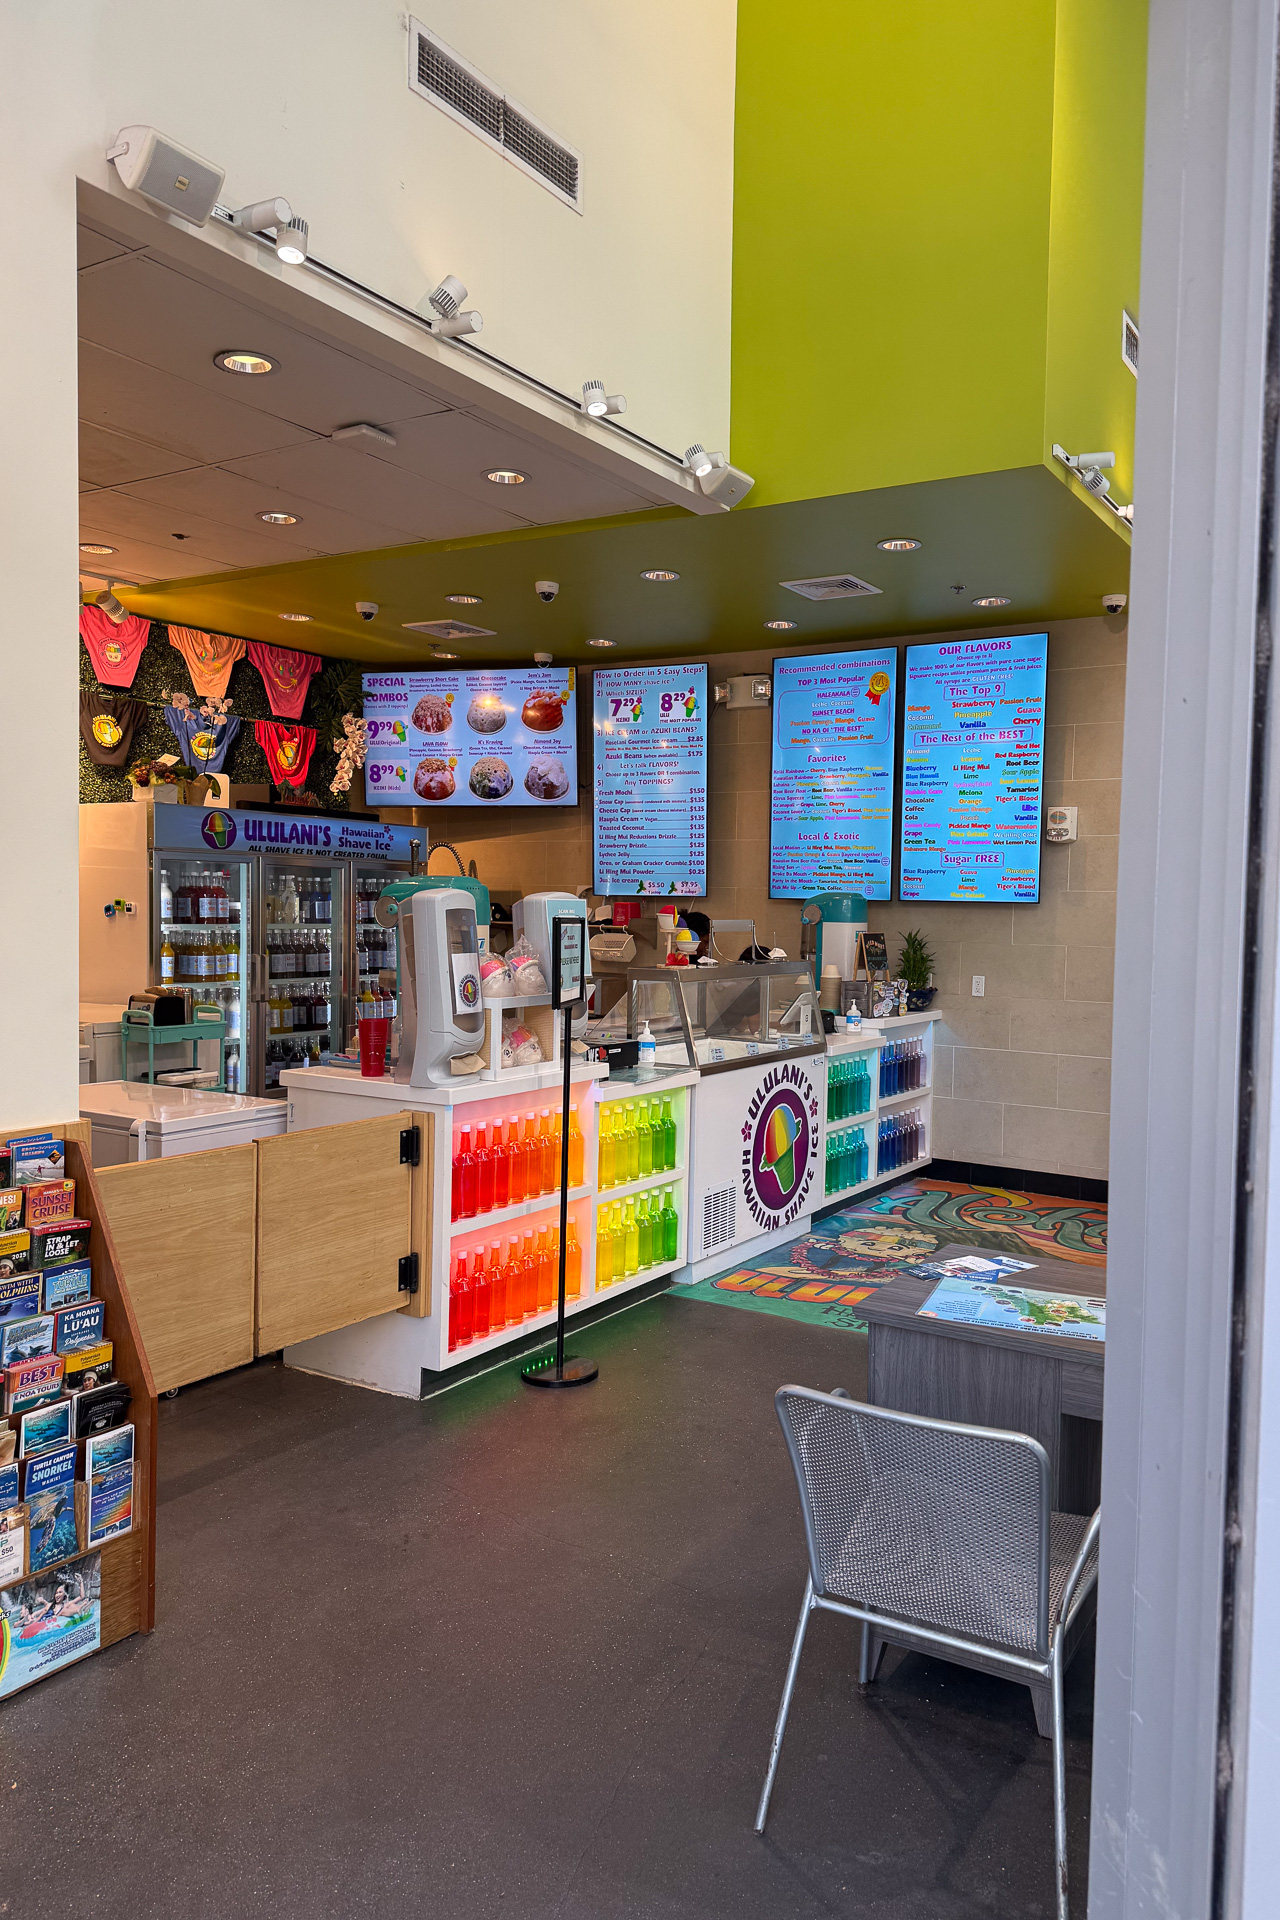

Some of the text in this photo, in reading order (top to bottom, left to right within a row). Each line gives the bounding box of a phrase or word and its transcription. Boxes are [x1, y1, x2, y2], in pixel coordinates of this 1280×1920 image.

[939, 641, 1012, 656] OUR FLAVORS
[664, 668, 680, 676] Easy
[683, 666, 704, 675] Steps!
[780, 659, 890, 674] Recommended combinations
[367, 678, 405, 687] SPECIAL
[838, 675, 865, 684] Popular
[950, 684, 1001, 697] The Top 9
[366, 693, 408, 702] COMBOS
[908, 705, 930, 713] Mango
[952, 700, 996, 708] Strawberry
[954, 710, 992, 719] Pineapple
[920, 730, 1025, 744] The Rest of the BEST
[243, 818, 331, 847] ULULANI'S
[342, 827, 385, 839] Hawaiian
[834, 832, 860, 840] Exotic
[265, 846, 291, 854] SHAVE
[338, 838, 392, 850] Shave Ice
[944, 855, 1000, 866] Sugar FREE
[748, 1063, 813, 1120] ULULANI'S
[742, 1149, 780, 1231] HAWAIIAN
[784, 1168, 815, 1226] SHAVE
[0, 1195, 16, 1205] ES!
[31, 1192, 73, 1208] SUNSET
[33, 1203, 70, 1219] CRUISE
[46, 1235, 71, 1244] STRAP
[44, 1248, 69, 1258] LOOSE
[17, 1278, 33, 1287] WITH
[52, 1273, 87, 1289] TURTLE
[0, 1283, 38, 1299] OLPHINS
[76, 1307, 100, 1319] MOANA
[20, 1363, 61, 1387] BEST
[37, 1382, 60, 1394] TOURS
[33, 1452, 74, 1472] TURTLE CANYON
[32, 1460, 72, 1483] SNORKEL
